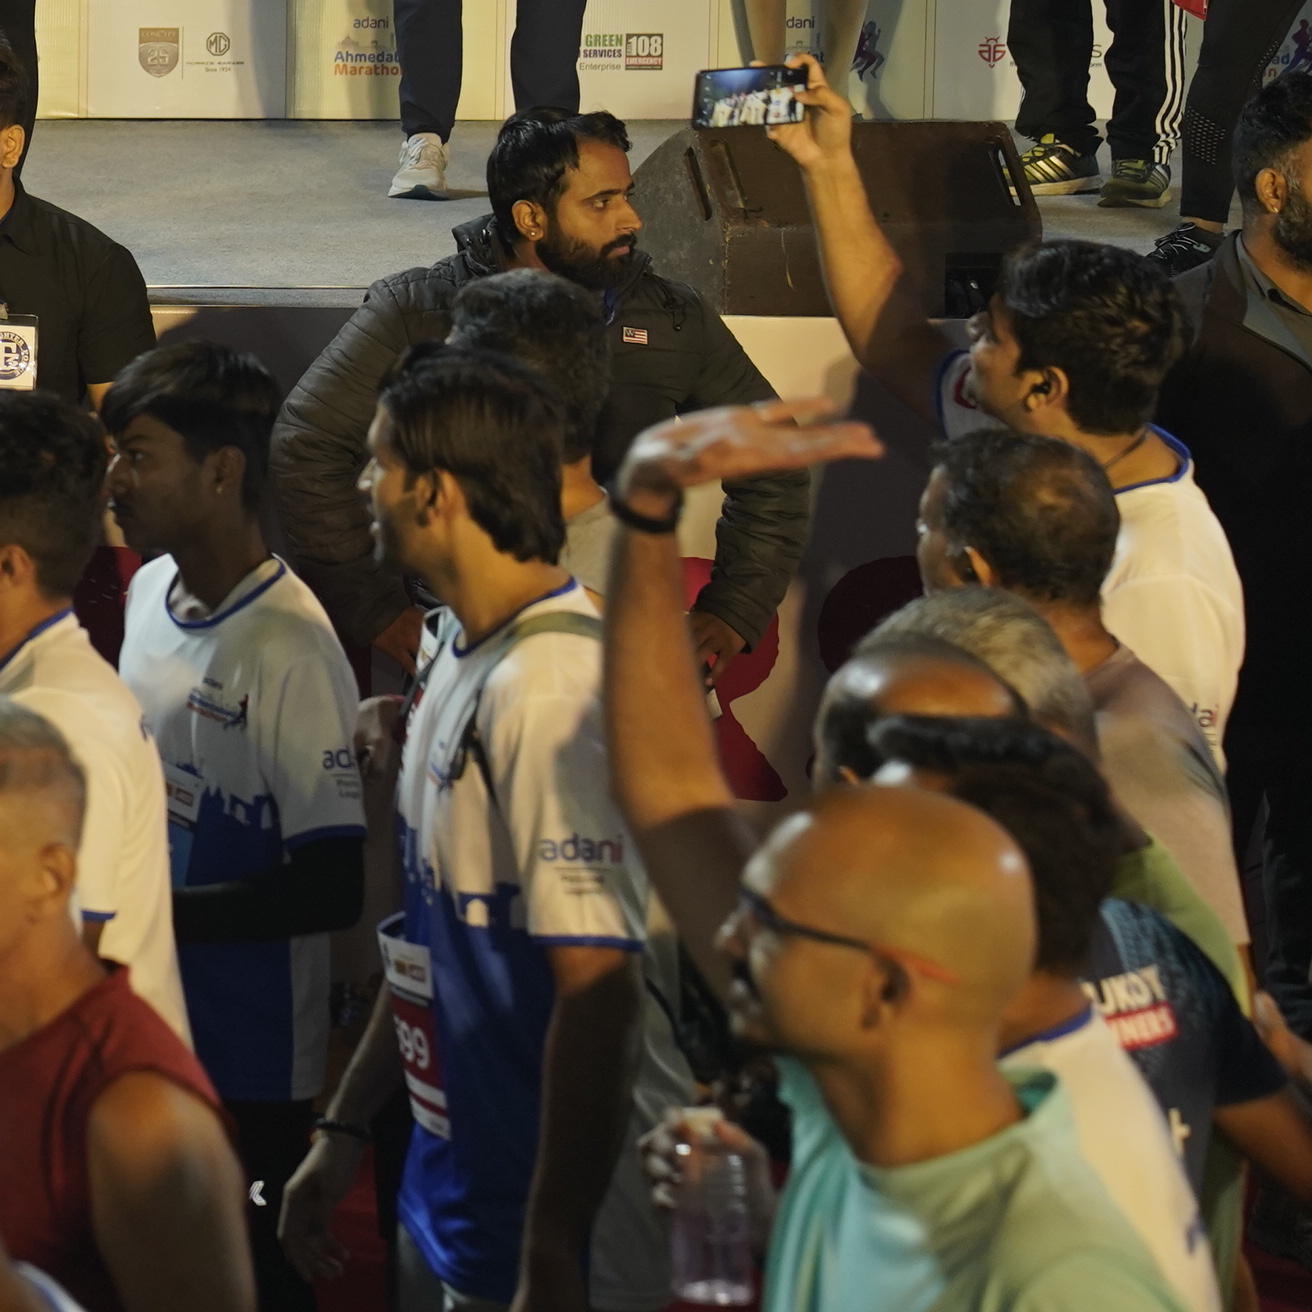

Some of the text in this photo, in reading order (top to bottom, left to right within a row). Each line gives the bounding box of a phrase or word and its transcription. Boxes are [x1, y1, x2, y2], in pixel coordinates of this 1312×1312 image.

[353, 16, 389, 29] adani
[208, 34, 228, 54] MG
[585, 34, 623, 47] GREEN
[627, 35, 662, 57] 108
[147, 48, 169, 66] 25
[583, 49, 622, 58] SERVICES
[579, 62, 621, 72] Enterprise
[541, 833, 623, 864] adani
